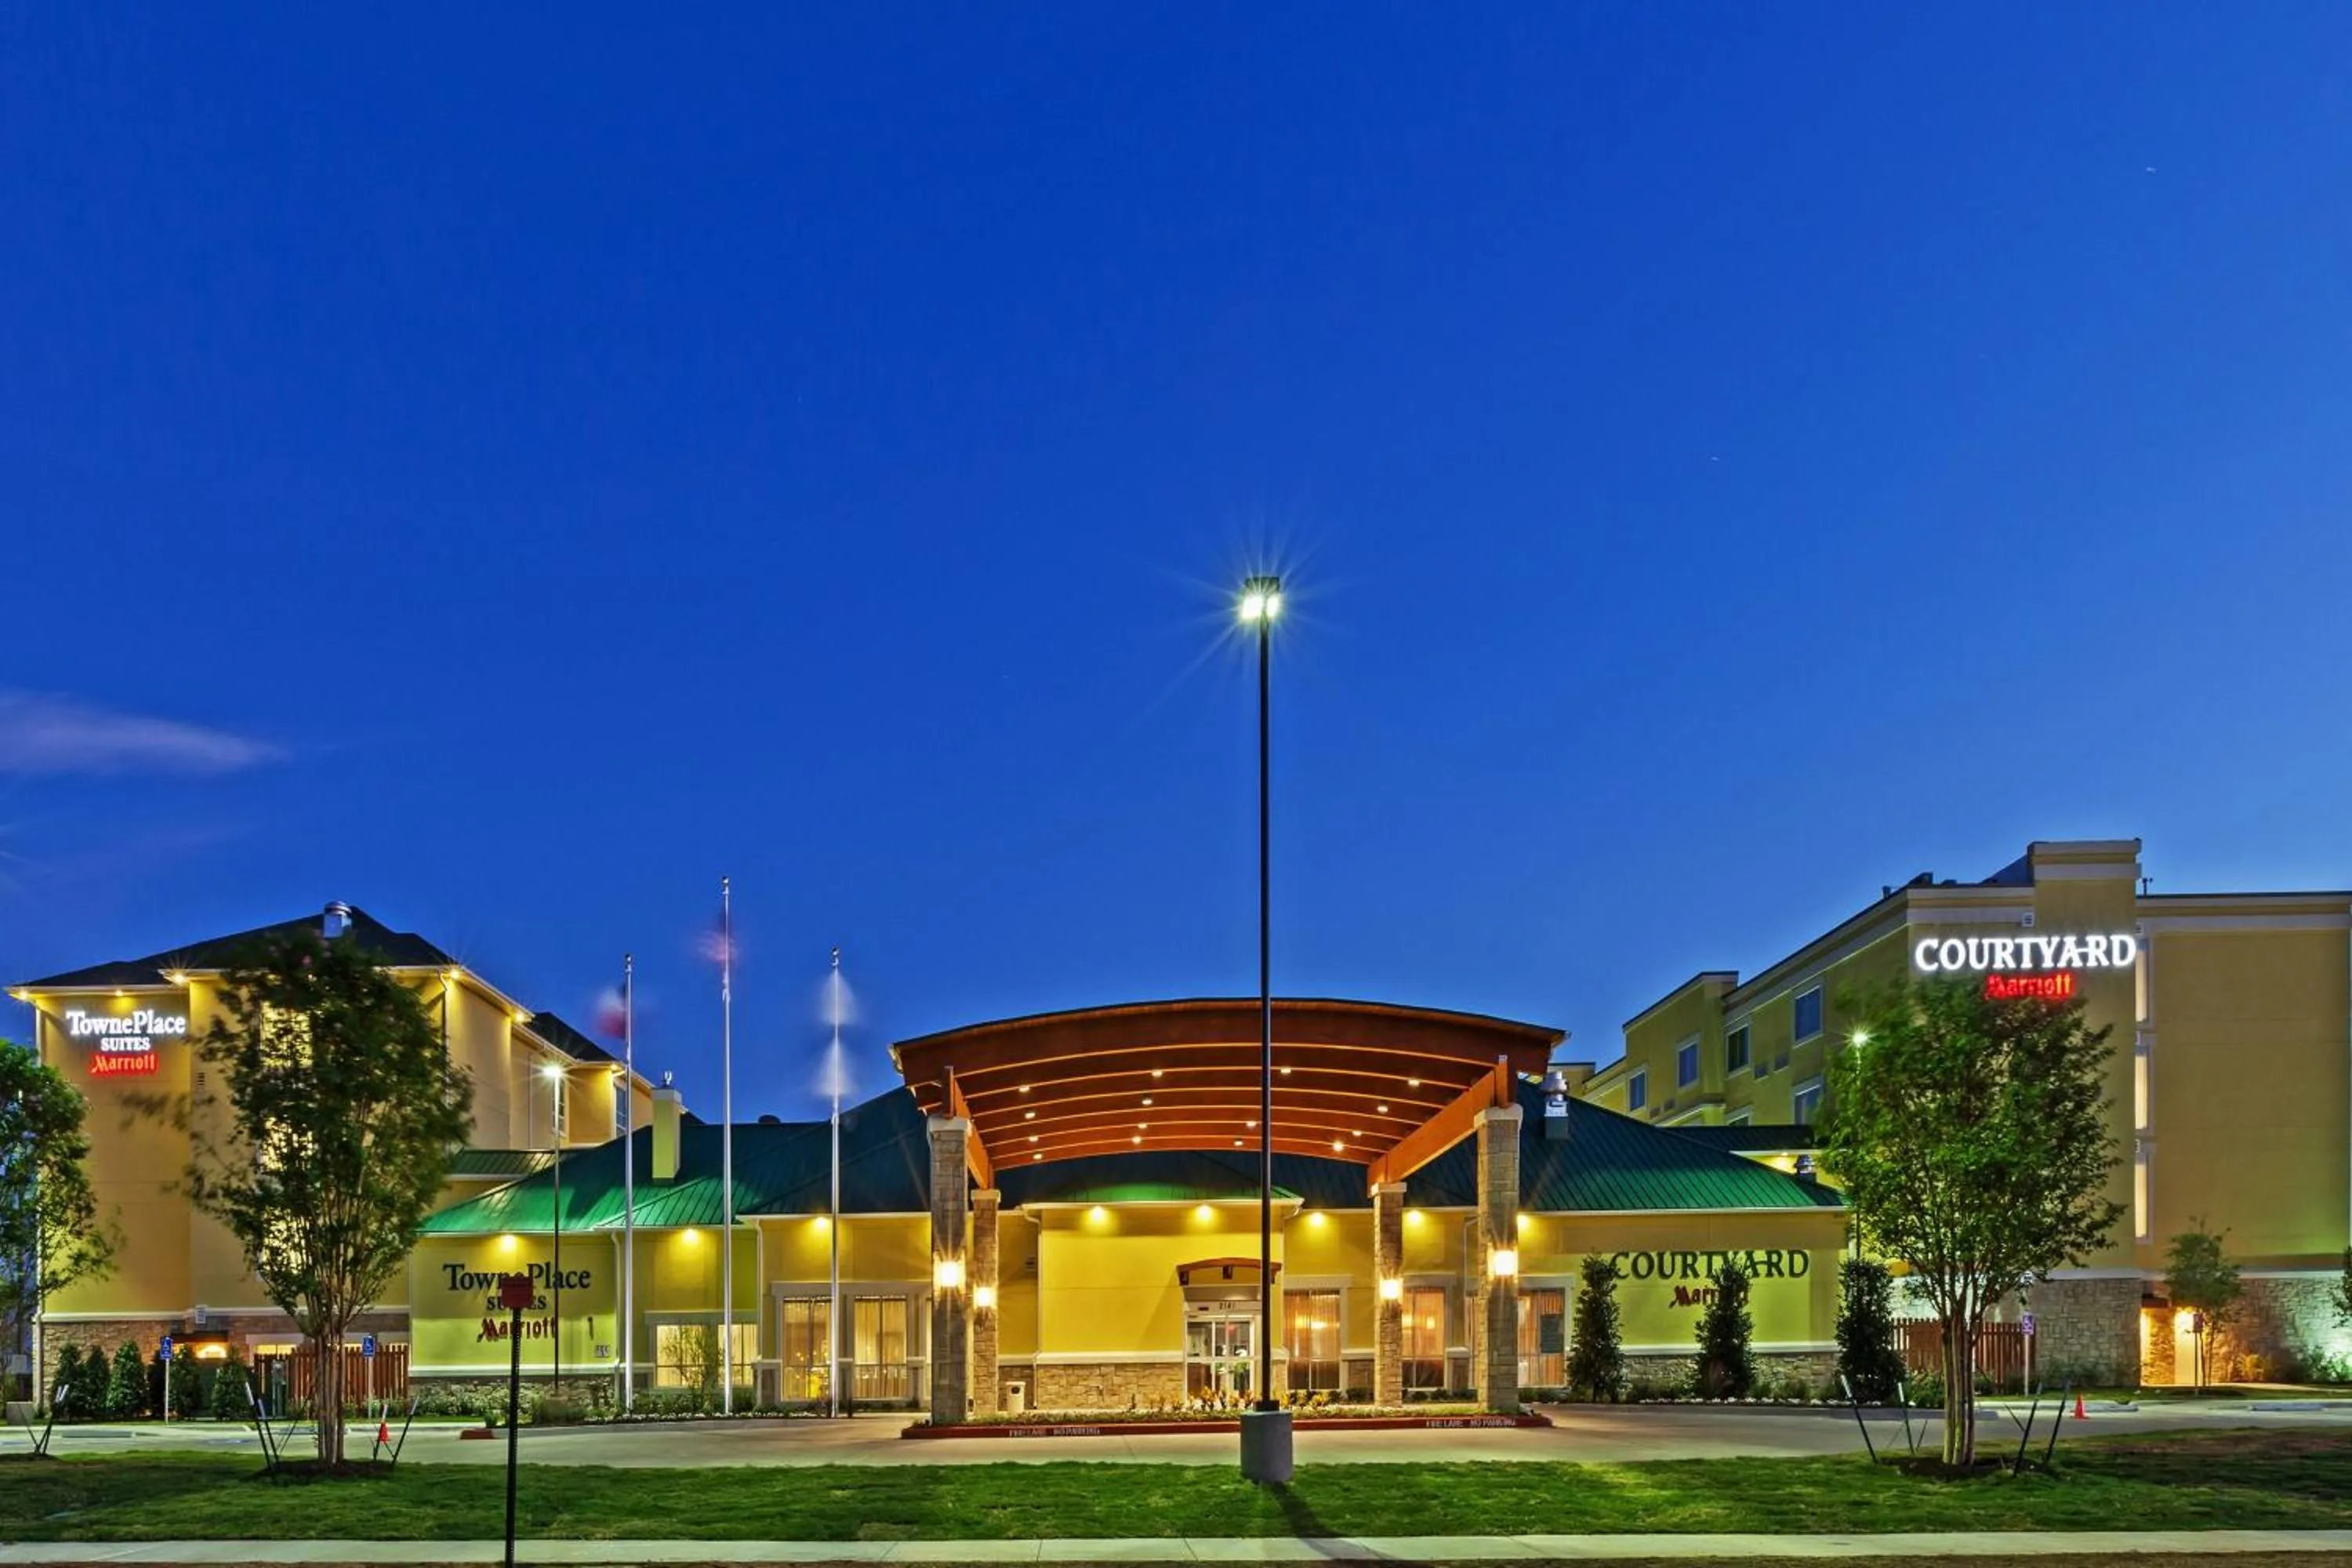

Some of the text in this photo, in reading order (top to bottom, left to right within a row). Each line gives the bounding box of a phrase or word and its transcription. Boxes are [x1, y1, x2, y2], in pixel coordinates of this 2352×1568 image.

[1915, 935, 2137, 971] COURTYARD
[66, 1009, 186, 1036] TownePlace
[100, 1037, 151, 1051] SUITES
[91, 1054, 156, 1073] Marriott
[443, 1261, 591, 1291] TowPlace
